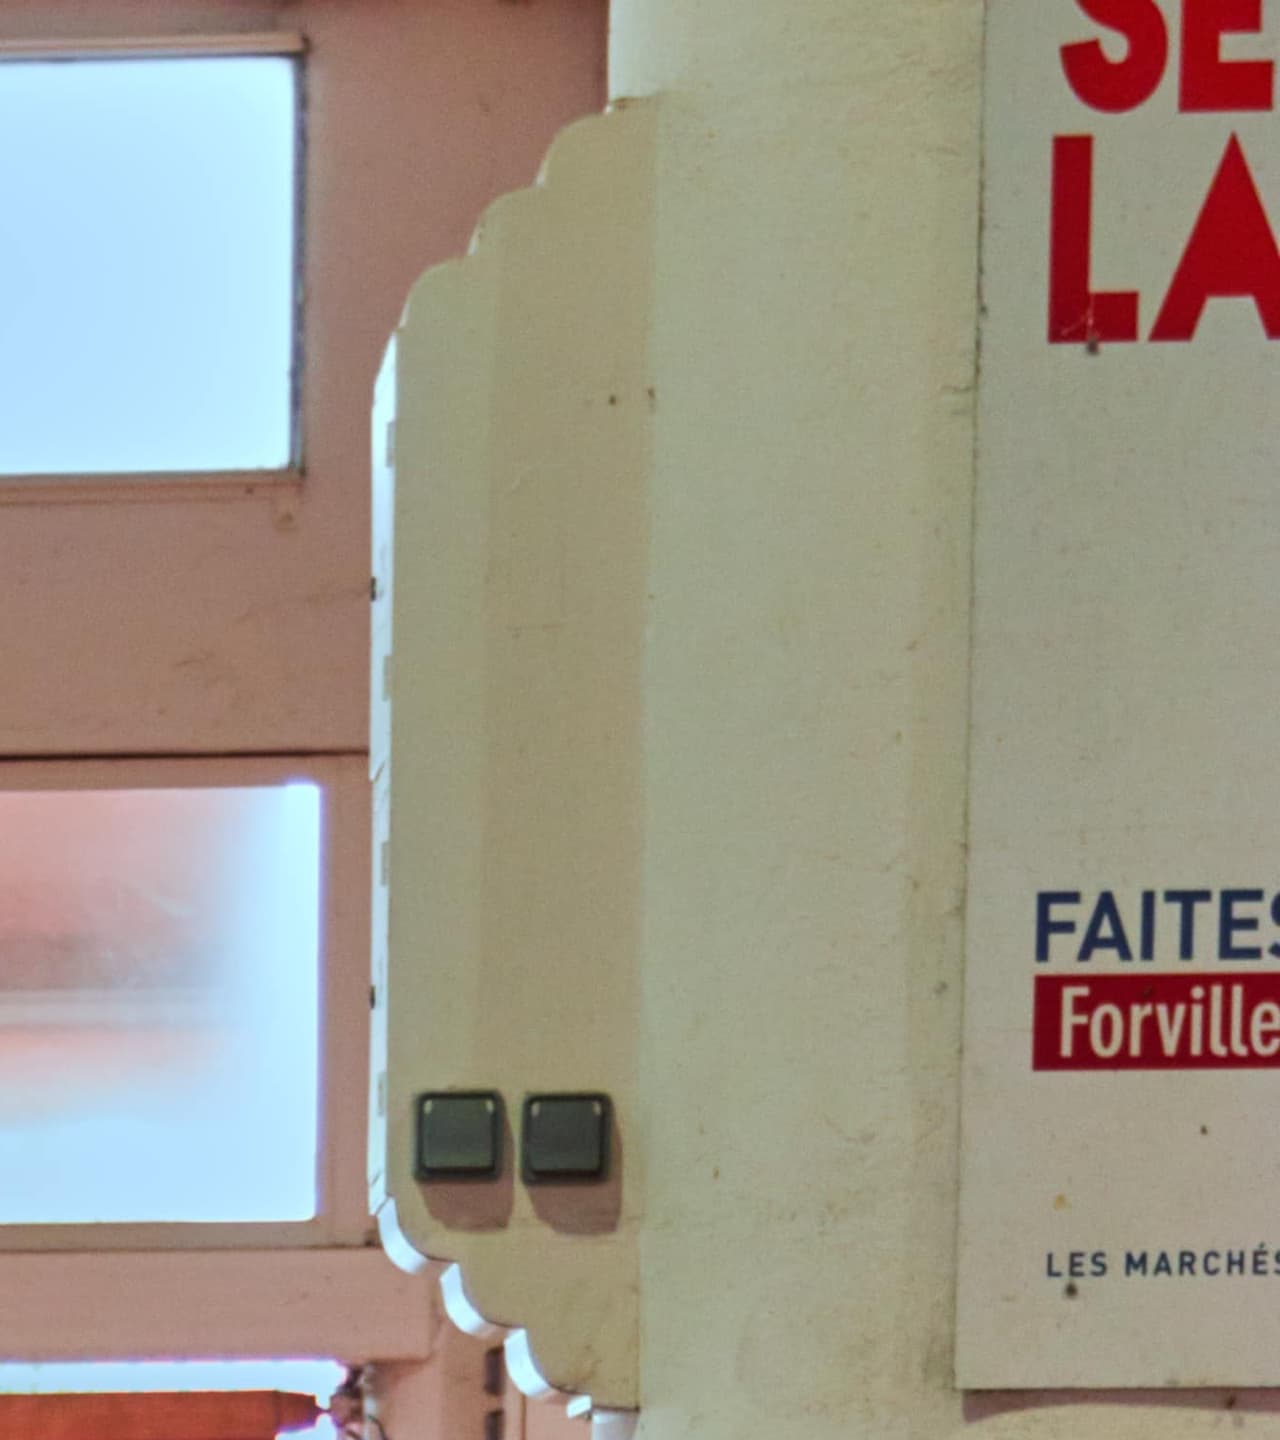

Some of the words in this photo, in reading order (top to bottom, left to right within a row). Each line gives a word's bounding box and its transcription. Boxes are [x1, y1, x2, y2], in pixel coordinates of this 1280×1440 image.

[1035, 889, 1280, 962] FAITE
[1059, 982, 1280, 1058] Forville
[1046, 1252, 1108, 1278] LES
